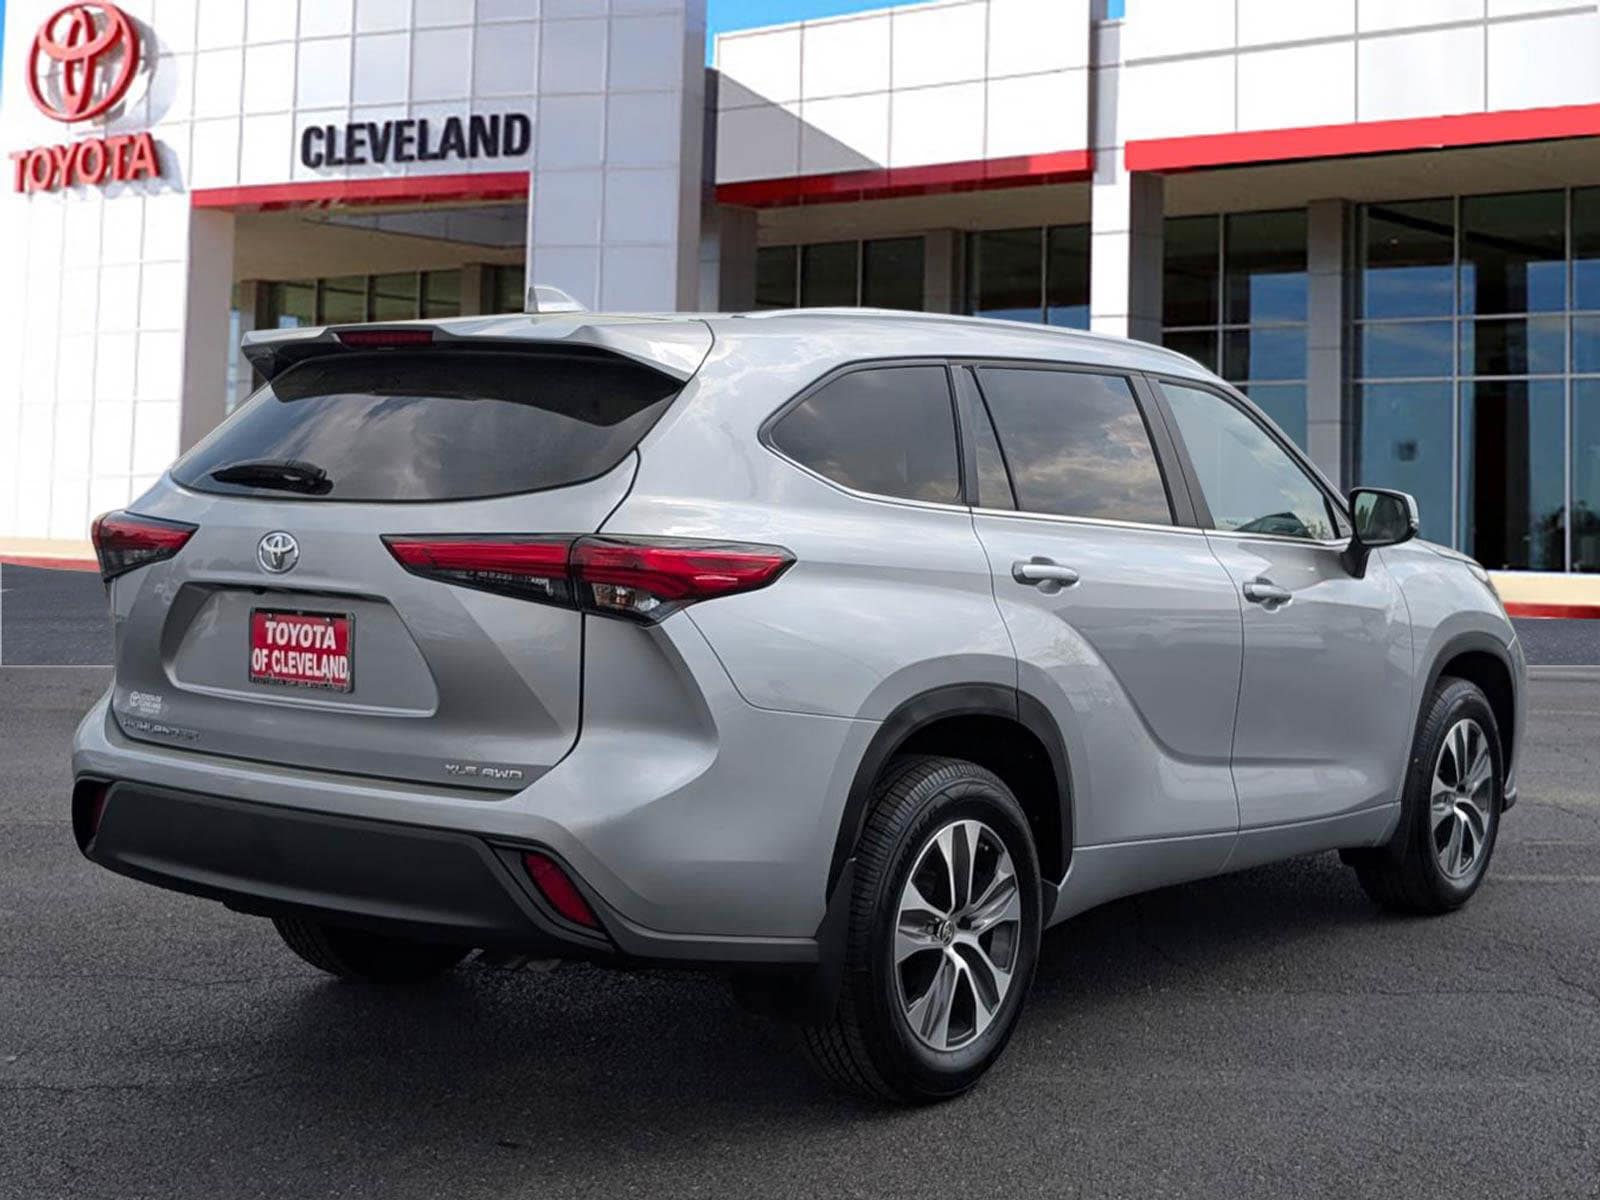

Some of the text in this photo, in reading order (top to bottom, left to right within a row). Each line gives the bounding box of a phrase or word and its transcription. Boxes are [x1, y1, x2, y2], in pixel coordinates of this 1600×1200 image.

[301, 113, 531, 168] CLEVELAND
[9, 132, 162, 193] TOYOTA
[264, 620, 337, 650] TOYOTA
[252, 647, 348, 679] OF CLEVELAND
[445, 764, 523, 779] XLE AWD
